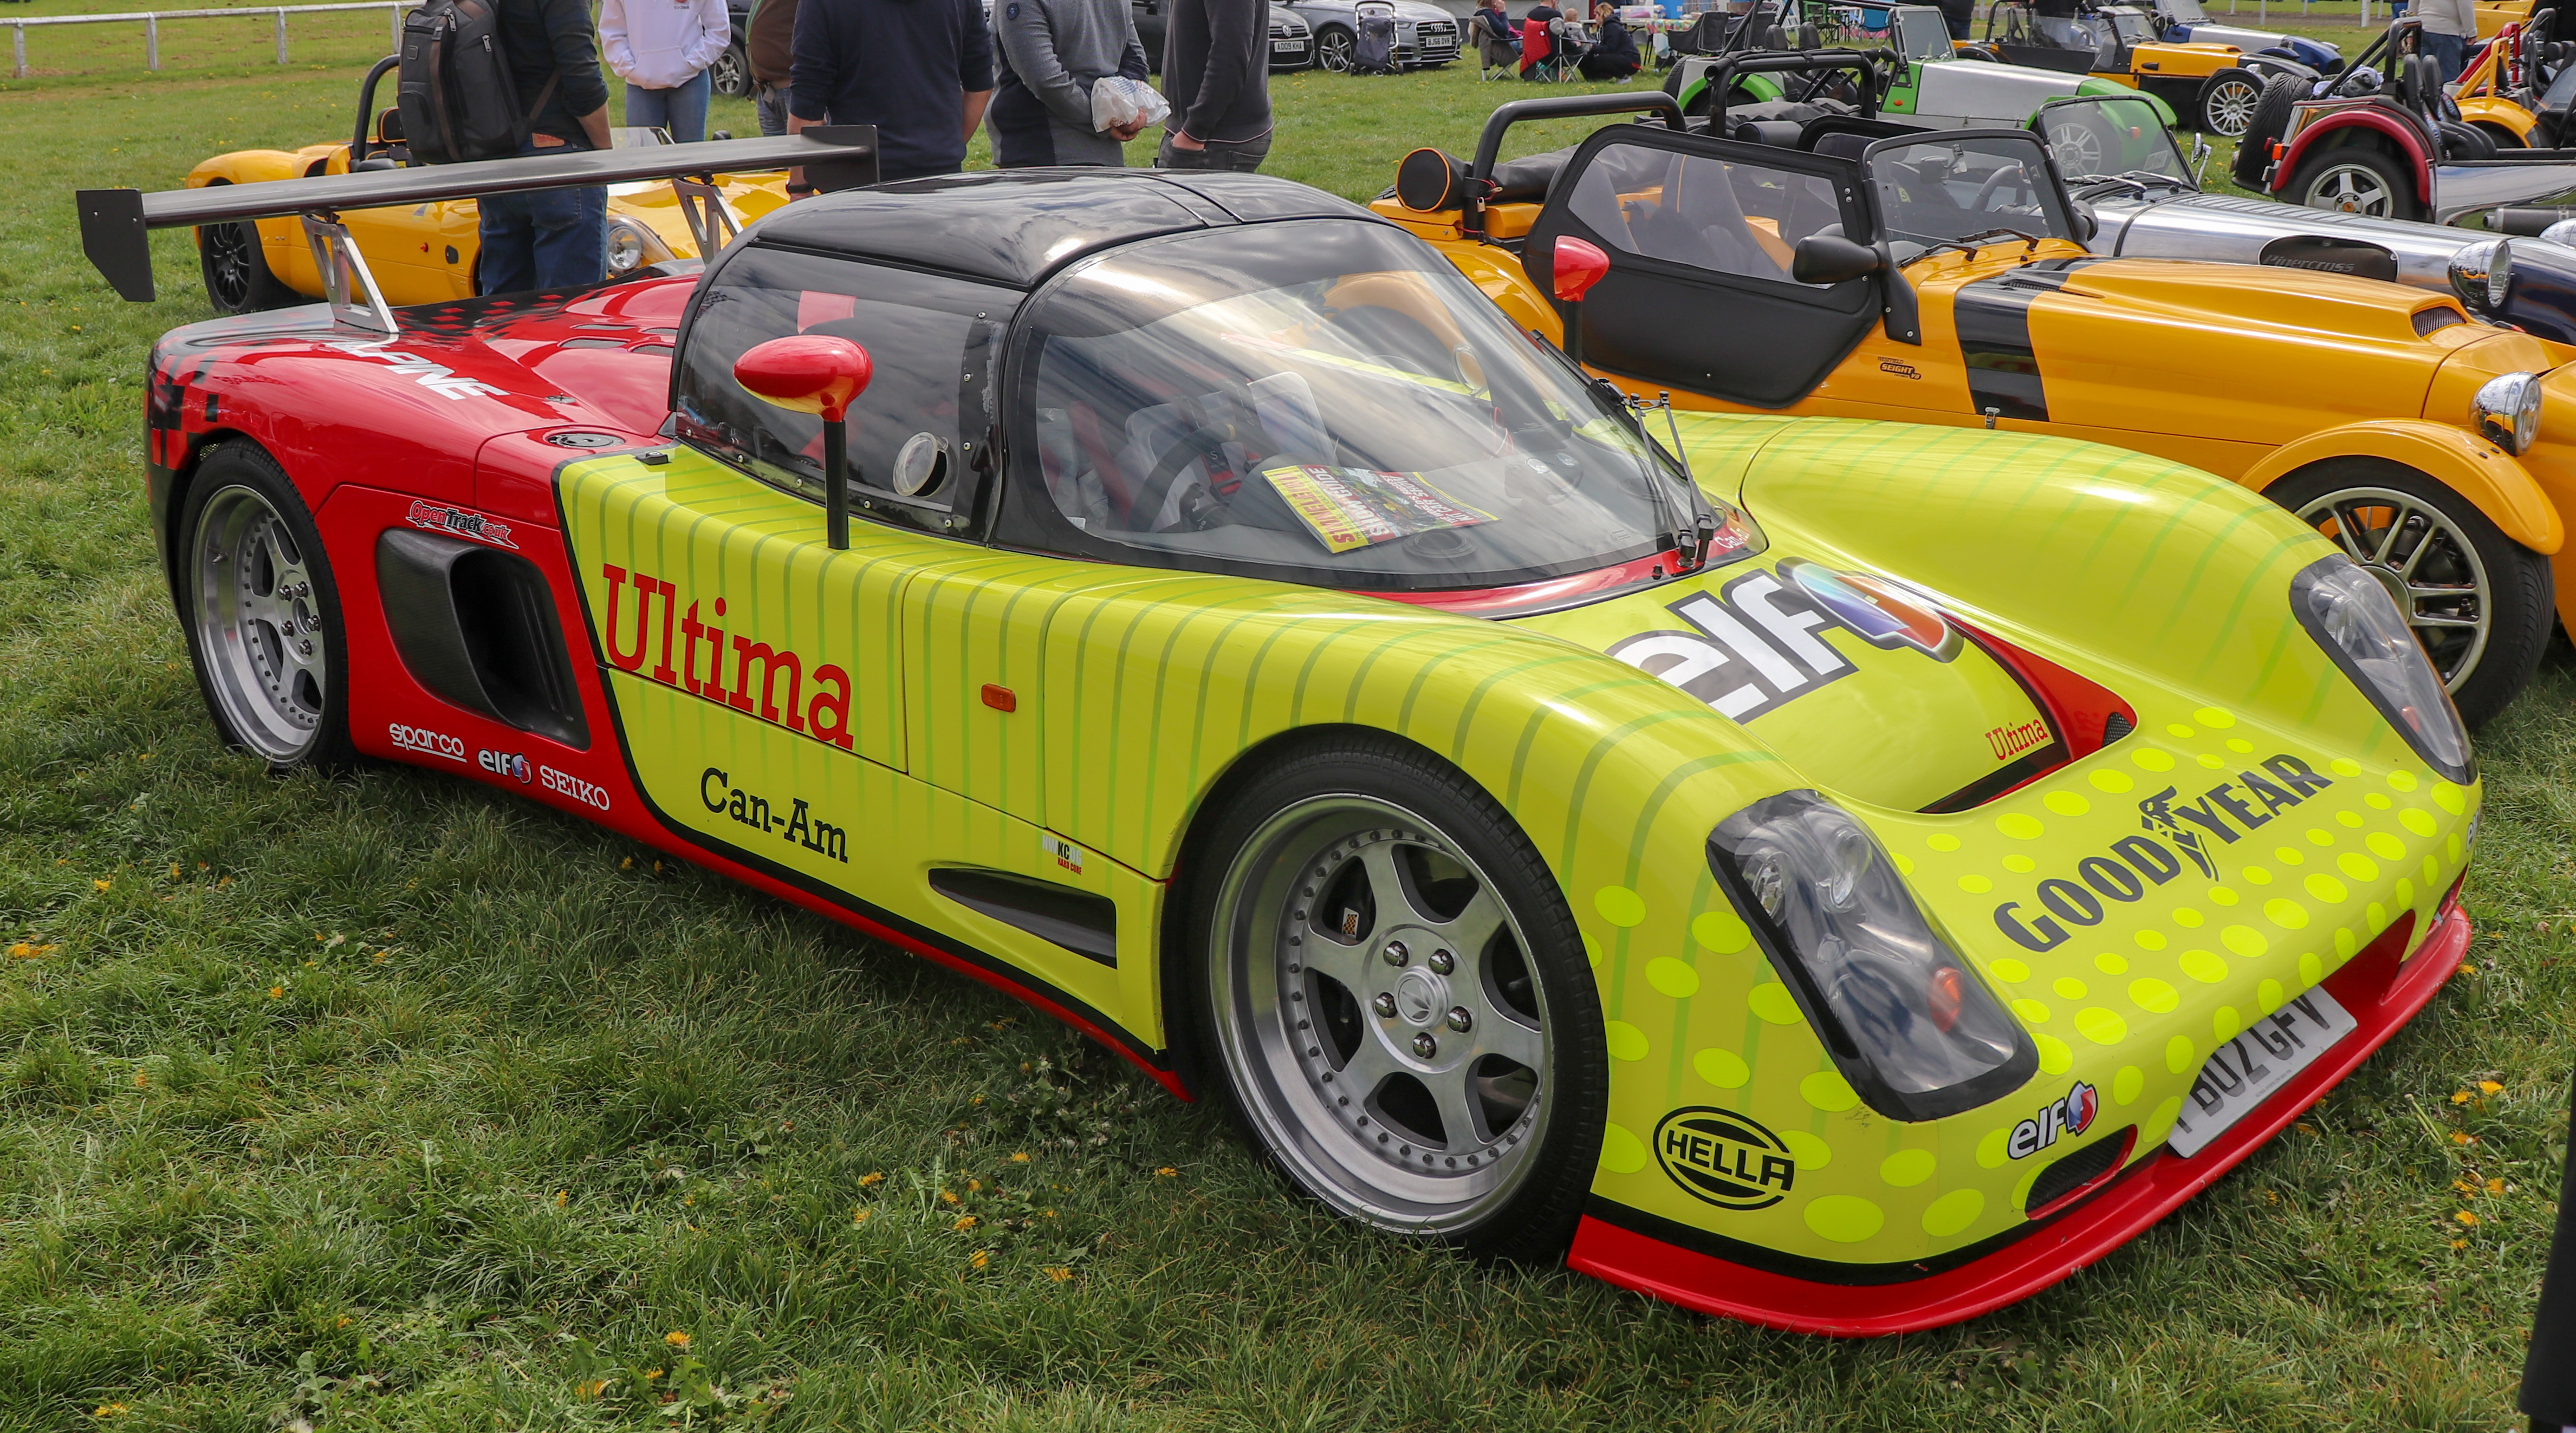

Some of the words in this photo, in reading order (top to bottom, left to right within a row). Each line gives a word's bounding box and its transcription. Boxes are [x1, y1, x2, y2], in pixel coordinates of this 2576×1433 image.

[1307, 467, 1353, 497] GUIDE
[1389, 476, 1429, 497] SHOW
[1342, 499, 1390, 536] SHOW
[1423, 499, 1453, 513] CAR
[1445, 513, 1474, 522] KIT
[603, 563, 854, 750] Ultima
[1608, 572, 1851, 722] elf
[389, 723, 465, 757] sparco
[1985, 719, 2048, 760] Ultima
[478, 751, 511, 776] elf
[540, 765, 610, 811] SEIKO
[701, 767, 848, 864] Can-Am
[1070, 863, 1082, 876] CORE
[1993, 754, 2334, 953] GOODYEAR
[2177, 1037, 2270, 1134] B02
[2008, 1097, 2066, 1159] elf
[1666, 1129, 1794, 1191] HELLA
